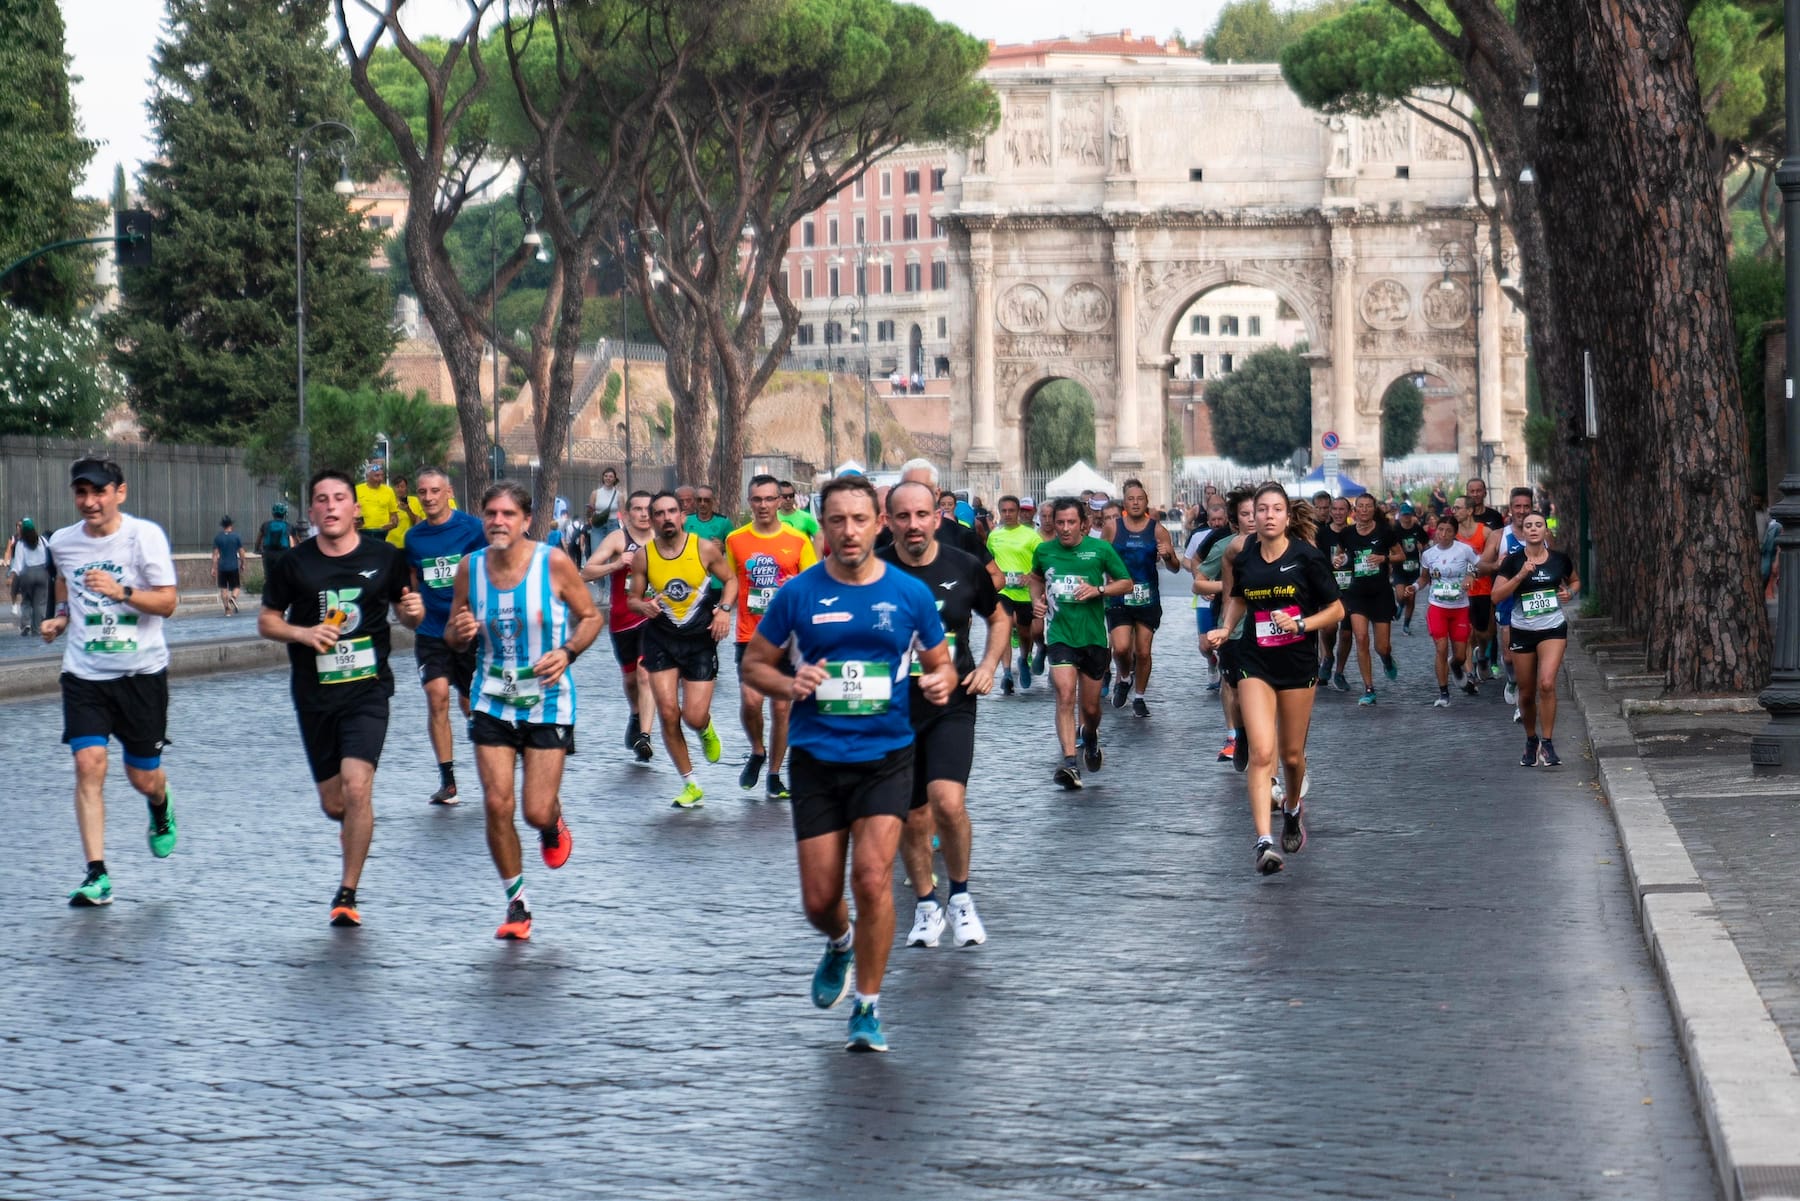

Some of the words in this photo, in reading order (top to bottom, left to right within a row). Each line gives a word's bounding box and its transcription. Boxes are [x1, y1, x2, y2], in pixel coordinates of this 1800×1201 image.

[757, 556, 774, 566] FOR
[434, 566, 452, 578] 972
[752, 565, 777, 575] EVERY
[755, 576, 774, 586] RUN
[1529, 598, 1551, 610] 2303
[488, 607, 522, 616] OLIMPIA
[842, 681, 862, 692] 334
